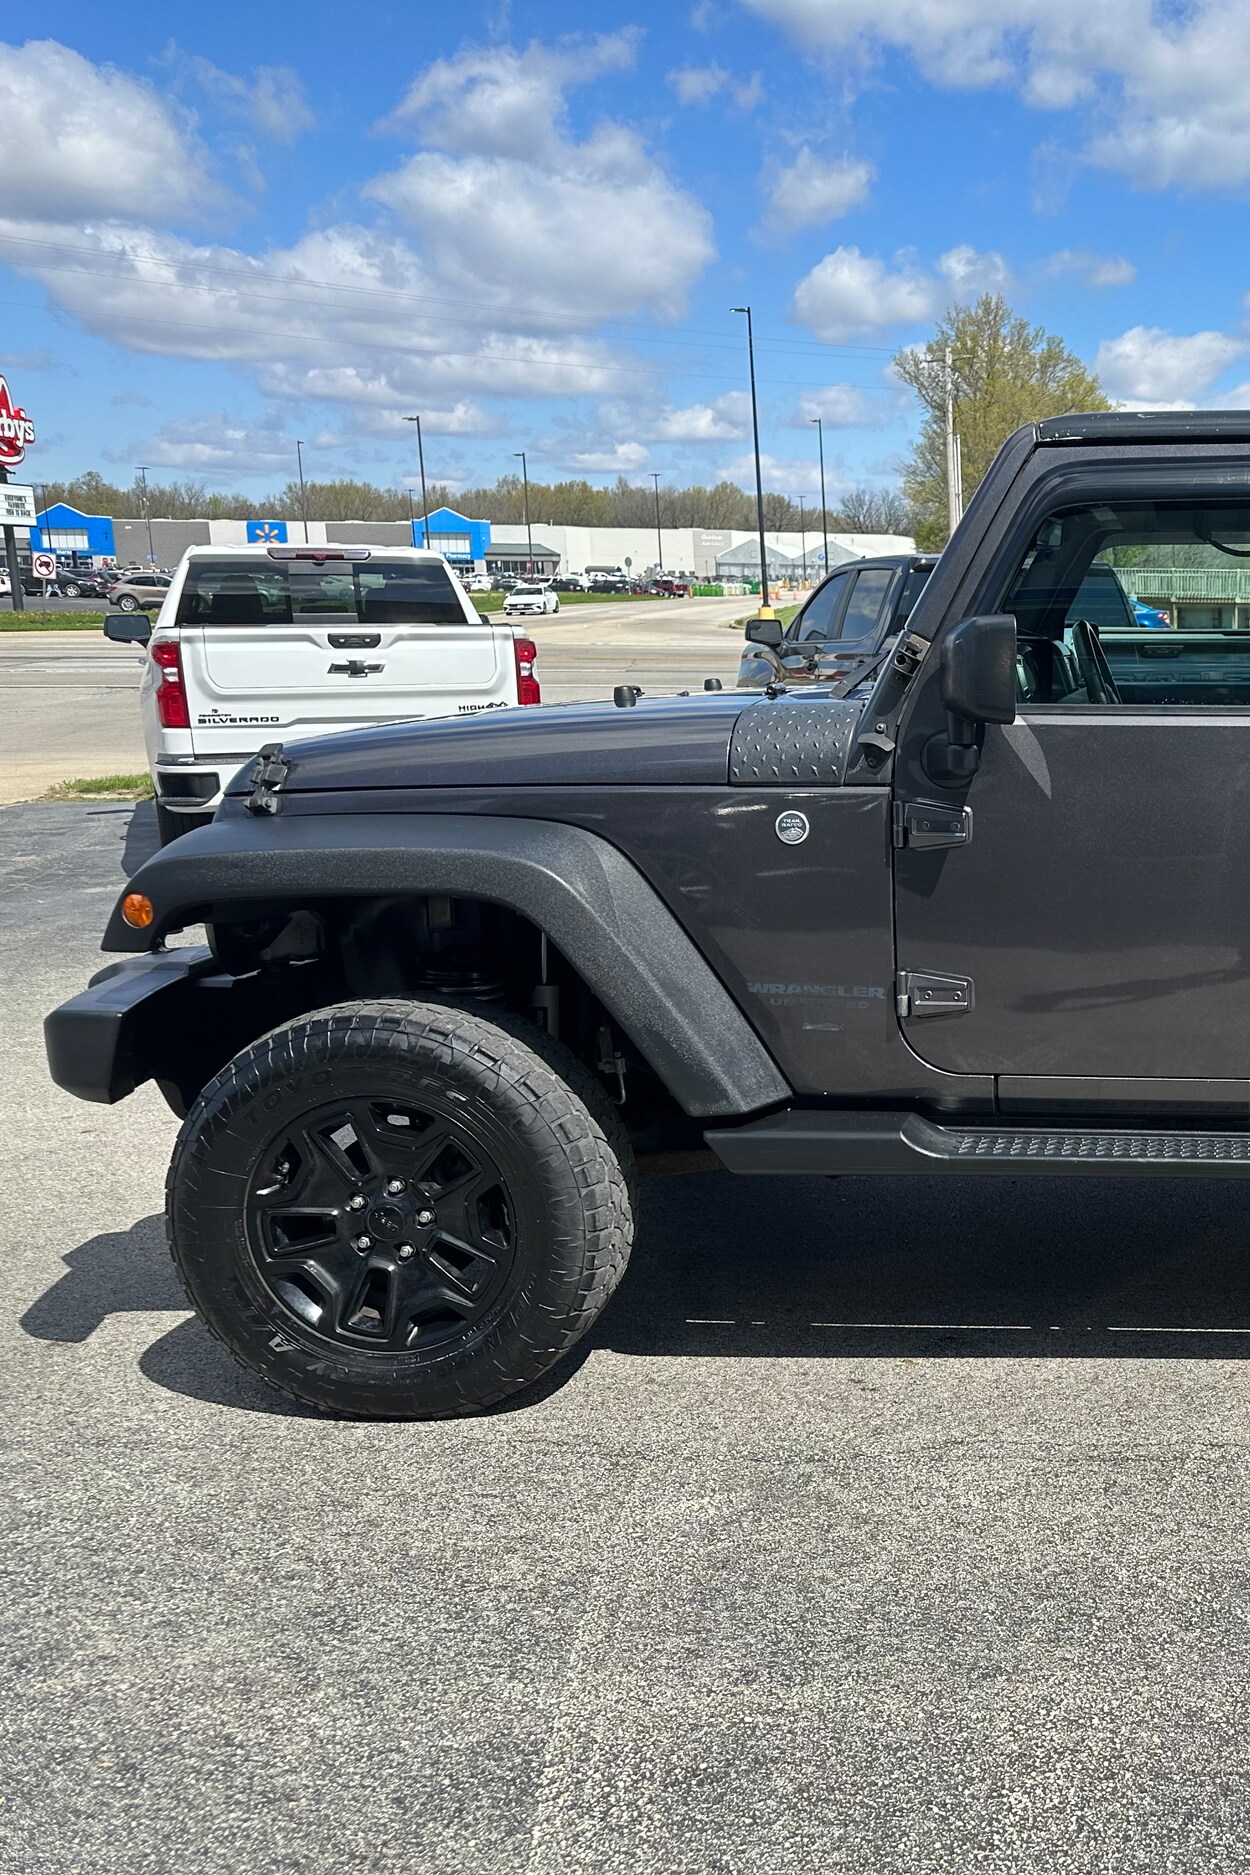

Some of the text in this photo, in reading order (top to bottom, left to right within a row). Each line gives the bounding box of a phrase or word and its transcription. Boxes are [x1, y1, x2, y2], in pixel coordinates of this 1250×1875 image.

[445, 552, 472, 561] Pharmacy
[197, 716, 280, 724] SILVERADO
[747, 982, 887, 1000] WRANGLER
